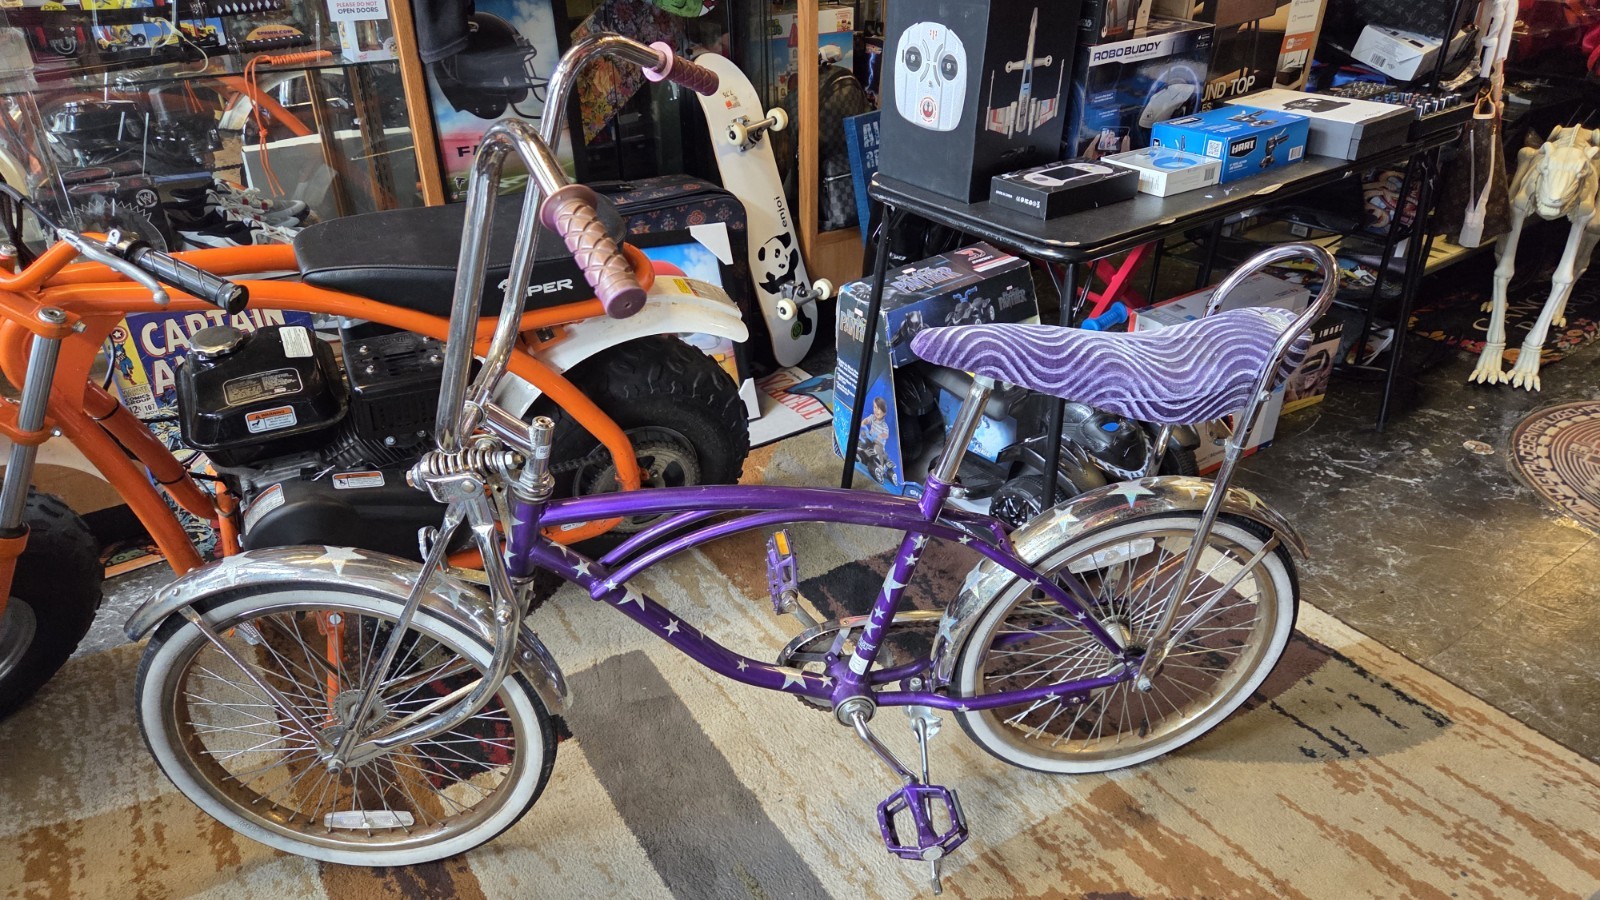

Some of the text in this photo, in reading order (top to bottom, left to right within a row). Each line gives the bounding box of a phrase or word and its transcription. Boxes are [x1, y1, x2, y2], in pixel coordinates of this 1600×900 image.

[1202, 75, 1255, 101] UND TOP
[1231, 139, 1255, 154] HART
[774, 196, 787, 228] enjoi
[141, 309, 286, 357] CAPTAIN
[1518, 408, 1581, 458] DECENTRALIZED
